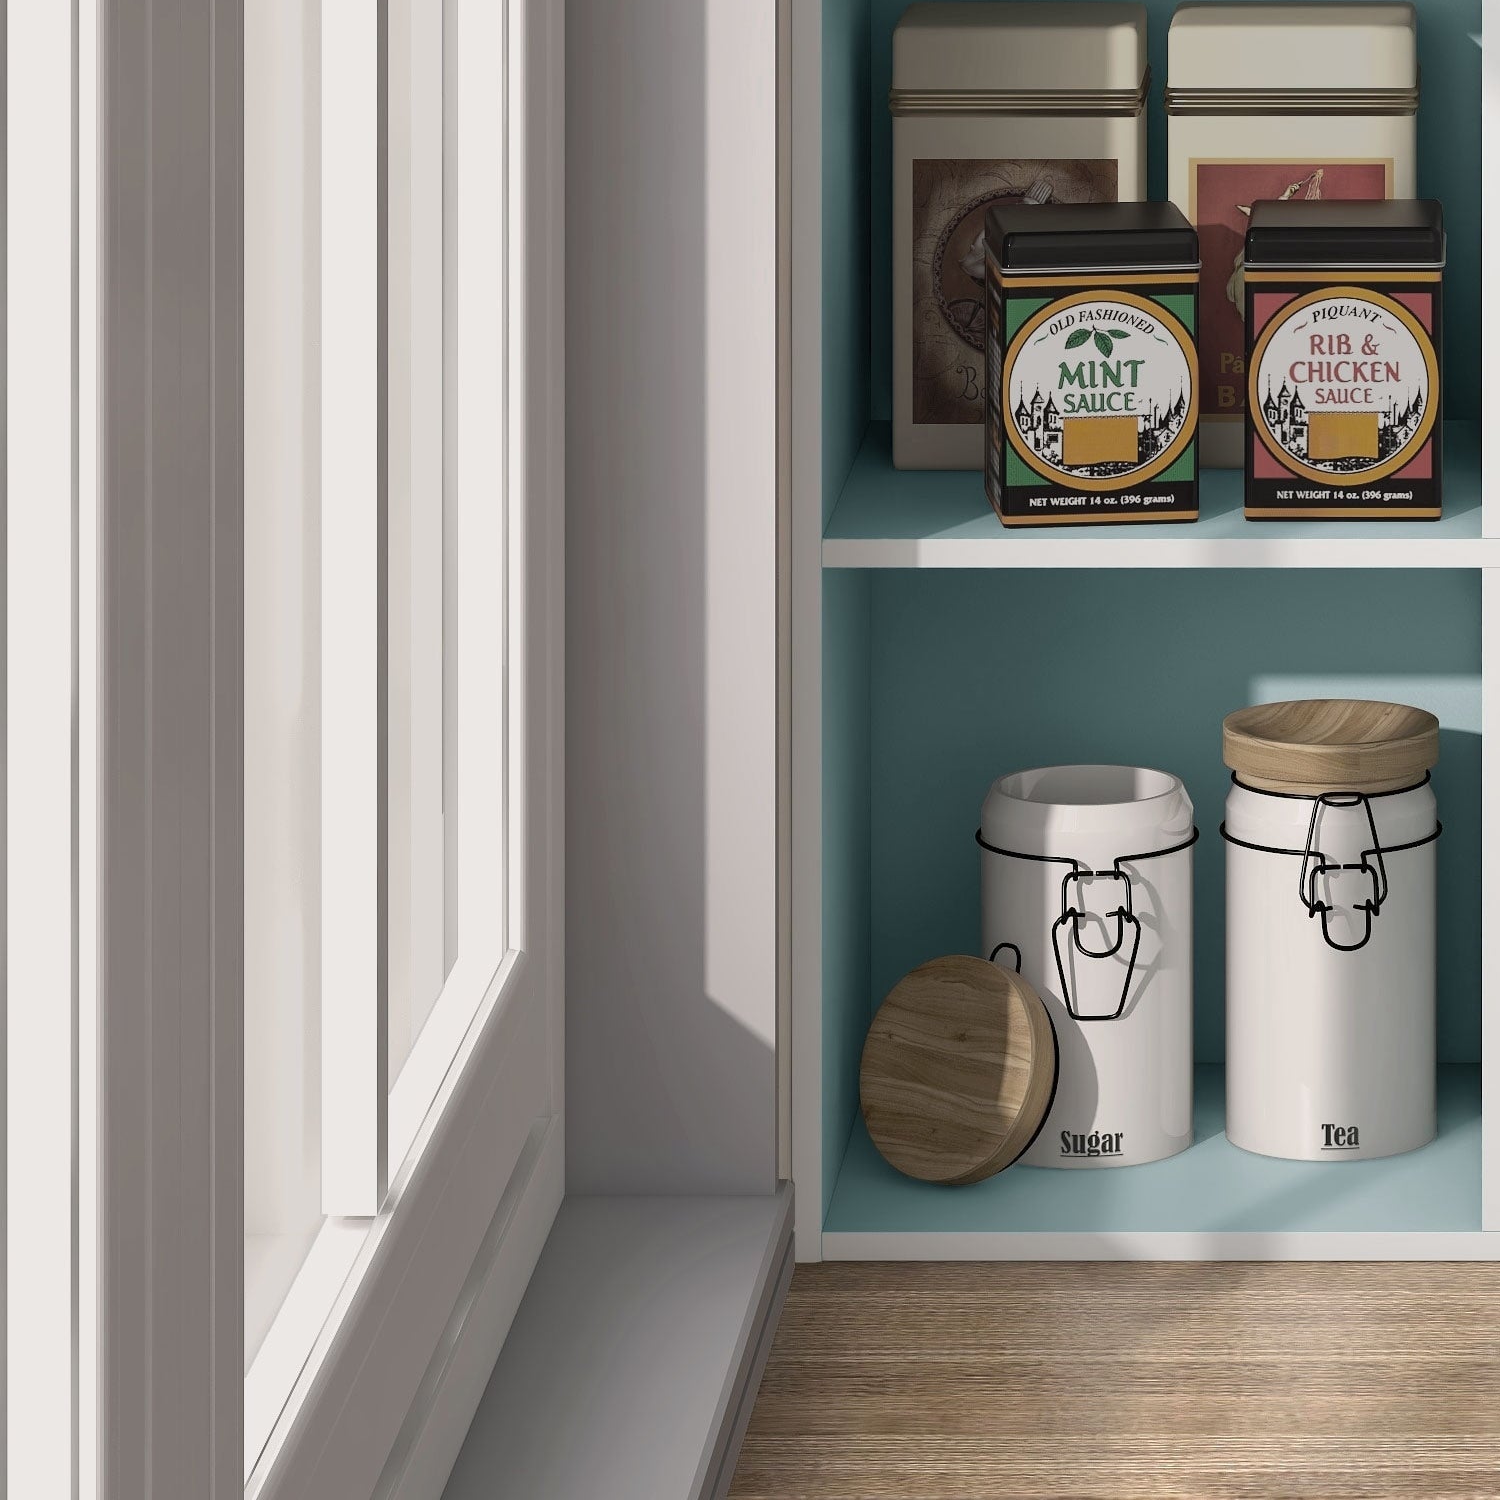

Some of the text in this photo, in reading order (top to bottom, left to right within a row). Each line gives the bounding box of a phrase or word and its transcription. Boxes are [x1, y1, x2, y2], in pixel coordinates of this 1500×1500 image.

[1049, 308, 1155, 336] OLD FASHIONED
[1312, 305, 1382, 323] PIQUANT
[1309, 334, 1380, 355] RIB &
[1058, 360, 1146, 389] MINT
[1289, 361, 1402, 383] CHICKEN
[1063, 391, 1137, 413] SAUCE
[1315, 387, 1375, 404] SAUCE
[1029, 493, 1175, 507] NET WEIGHT 14 oz. (396 grams)
[1276, 490, 1413, 501] NET WEIGHT 14 oz. (396 grams)
[1060, 1130, 1123, 1157] Sugar
[1321, 1123, 1360, 1147] Tea
